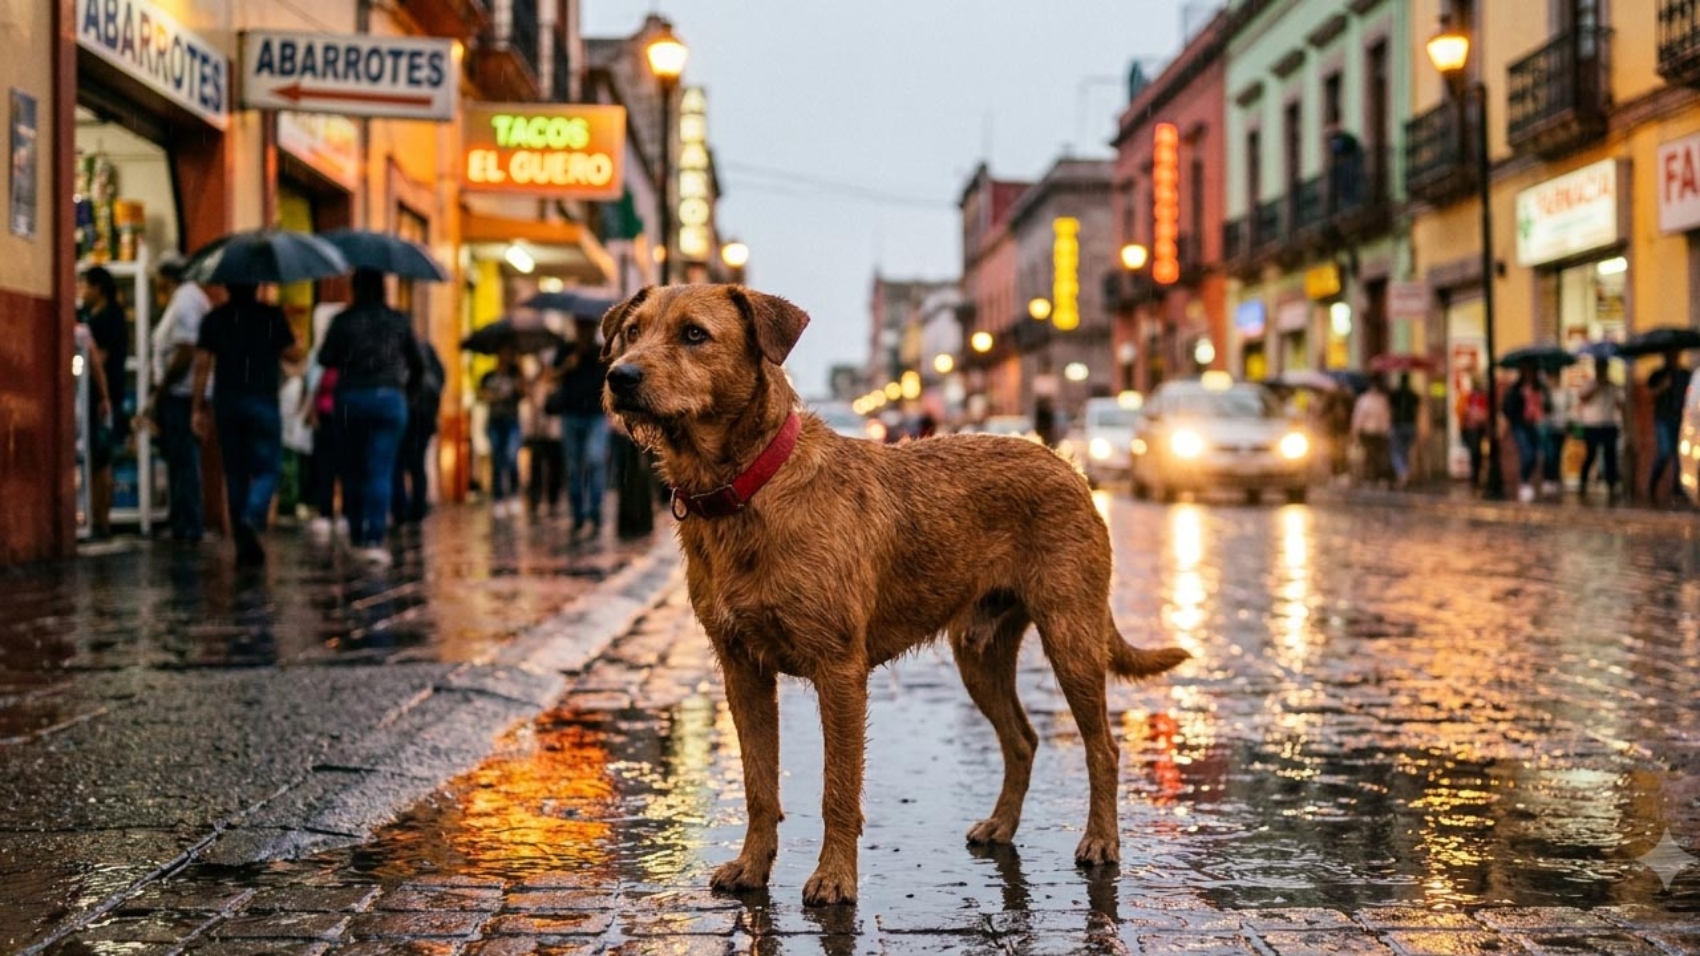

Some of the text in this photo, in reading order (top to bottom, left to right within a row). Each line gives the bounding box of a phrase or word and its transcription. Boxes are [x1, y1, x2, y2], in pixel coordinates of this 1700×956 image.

[83, 0, 222, 113] ABARROTES
[255, 36, 446, 89] ABARROTES
[491, 115, 590, 150] TACOS
[467, 149, 613, 186] EL GUERO
[1664, 143, 1700, 204] FA
